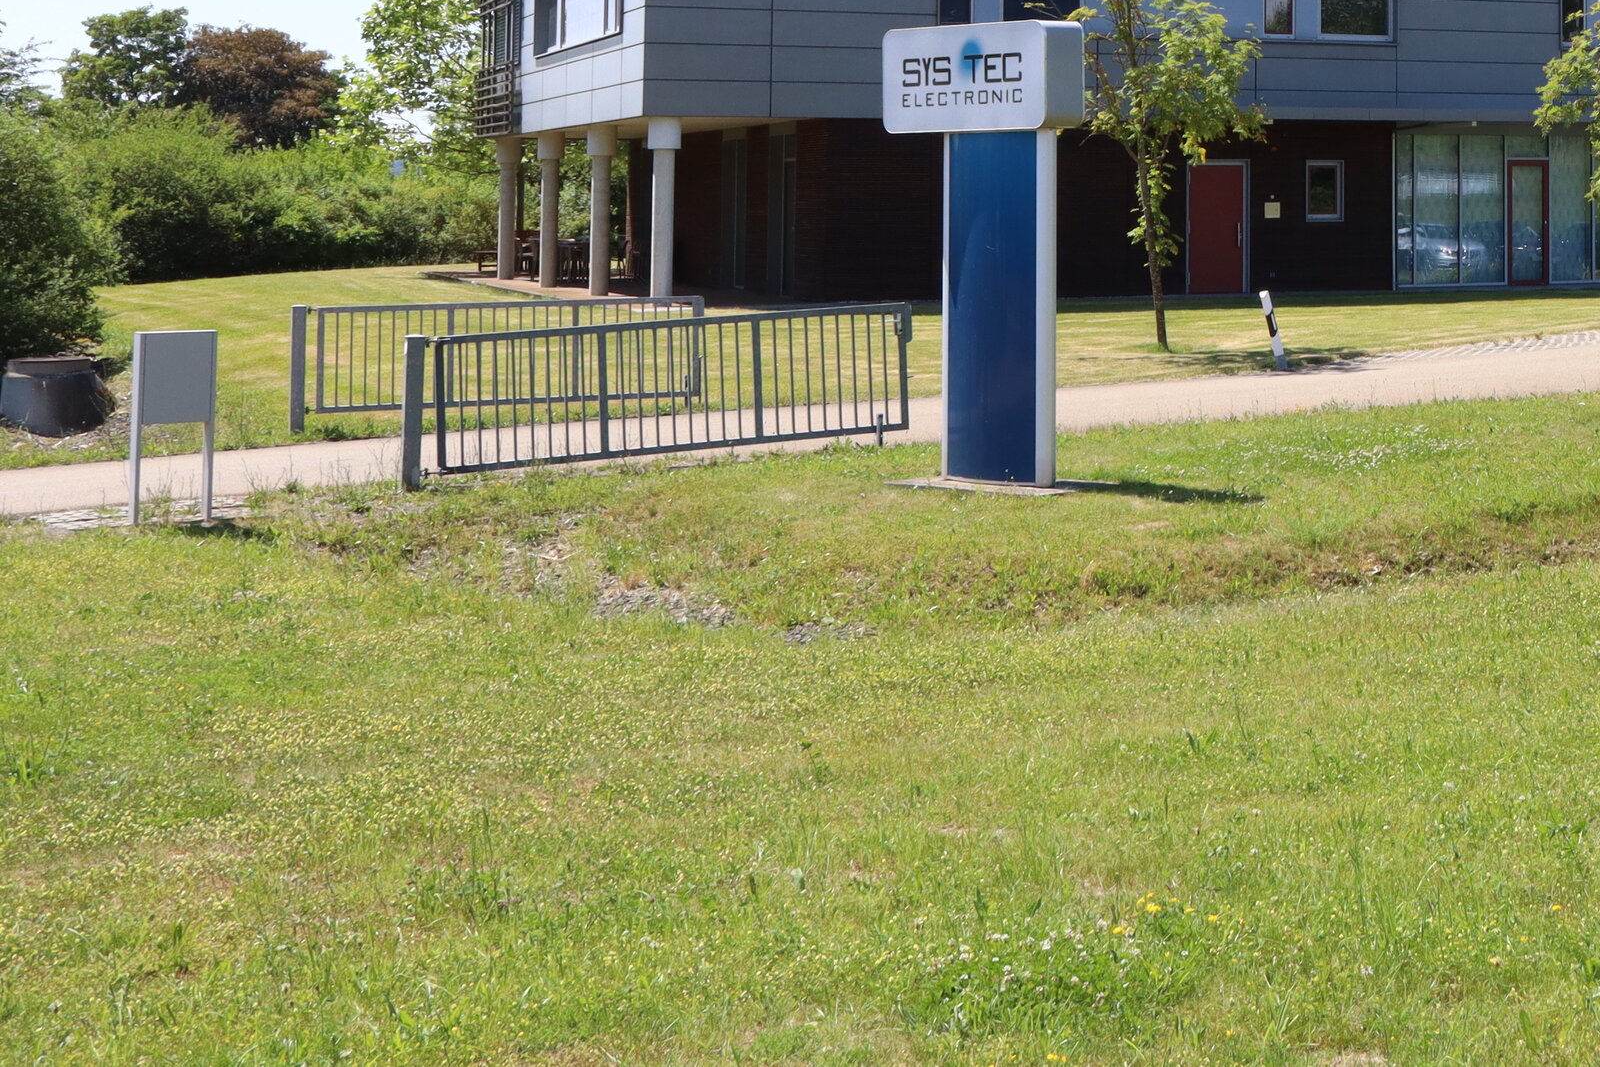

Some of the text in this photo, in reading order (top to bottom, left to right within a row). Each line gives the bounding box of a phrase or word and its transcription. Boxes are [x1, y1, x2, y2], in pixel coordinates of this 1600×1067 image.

[902, 52, 1022, 87] SYS TEC
[902, 88, 1023, 108] ELECTRONIC
